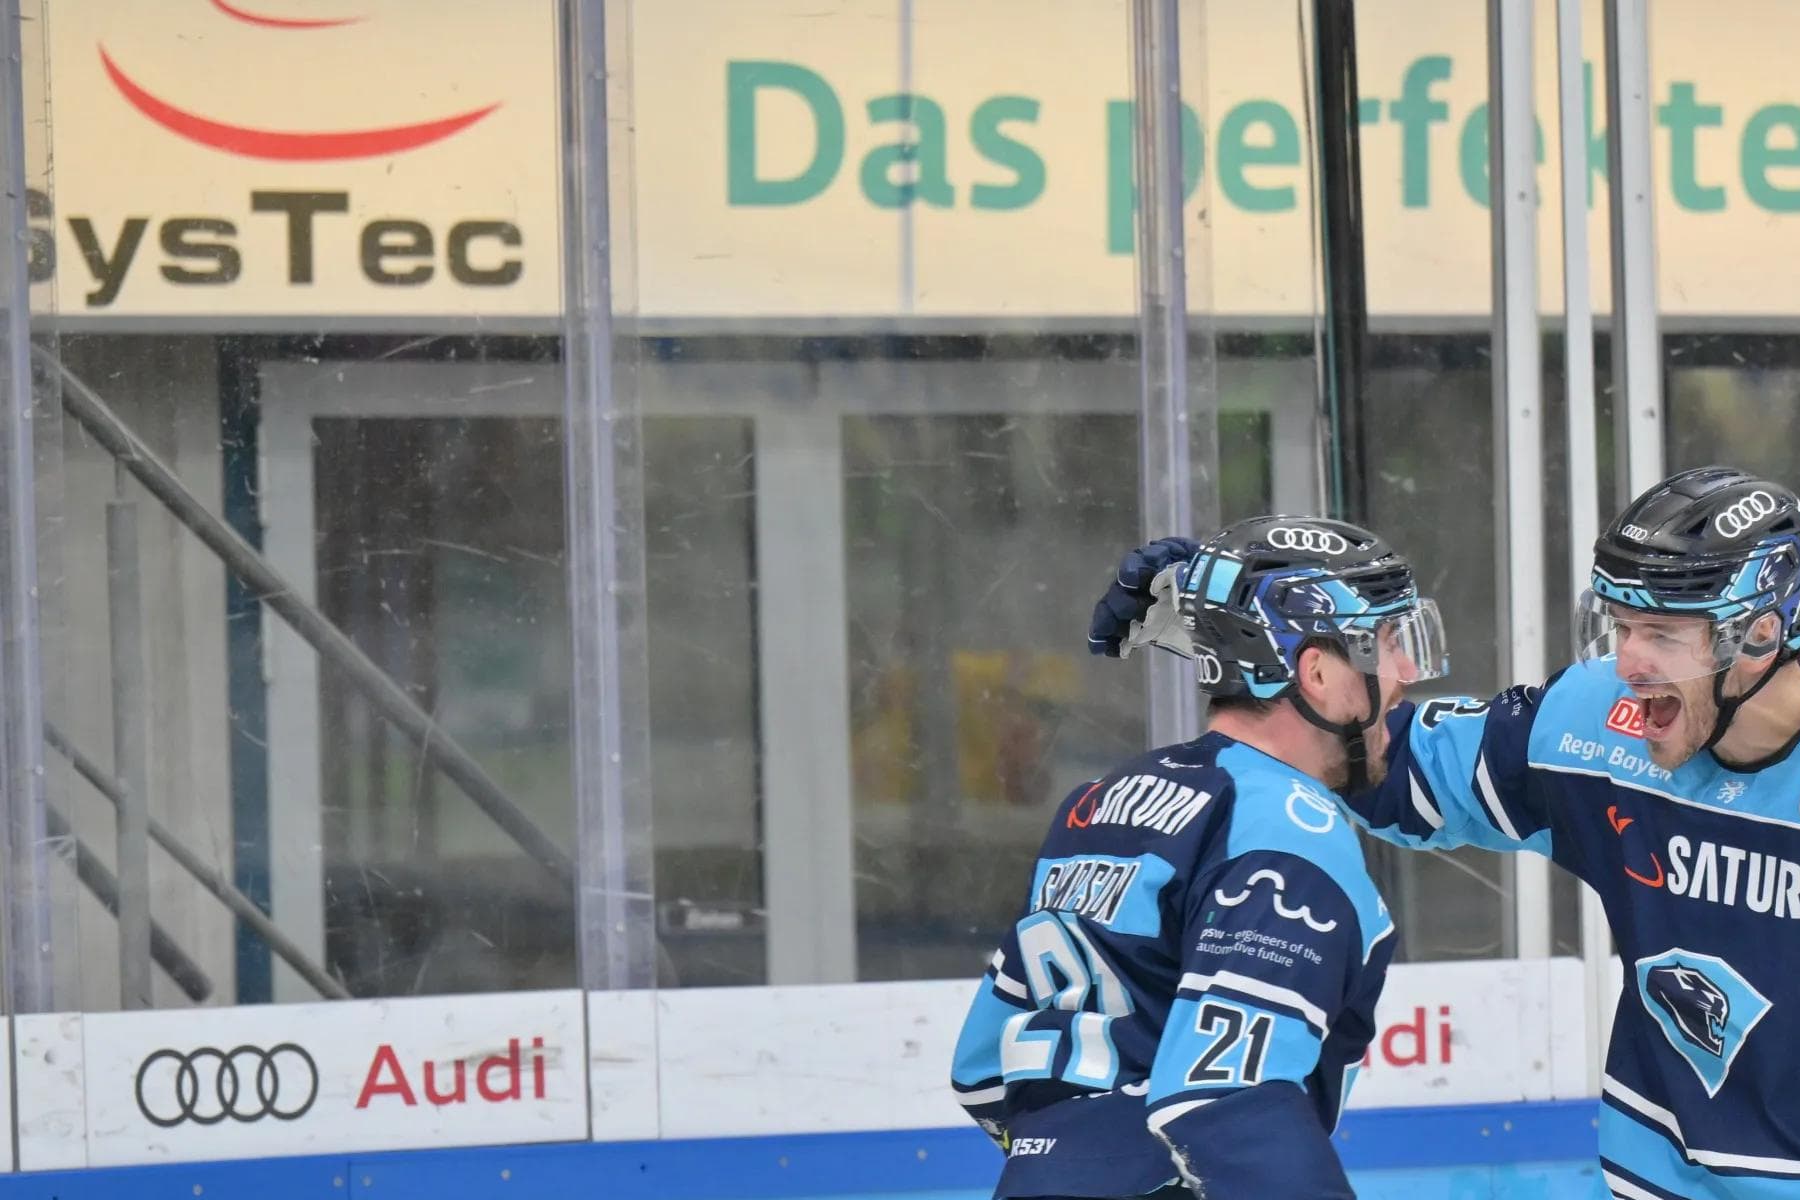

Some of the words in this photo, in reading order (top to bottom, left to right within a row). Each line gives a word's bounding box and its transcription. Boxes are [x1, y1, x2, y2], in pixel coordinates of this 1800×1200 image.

[727, 59, 955, 211] Das
[1091, 774, 1213, 837] SATURN
[1257, 947, 1294, 967] future
[1303, 947, 1323, 965] the
[1185, 1000, 1275, 1088] 21
[1364, 1004, 1452, 1066] di
[357, 1037, 546, 1109] Audi
